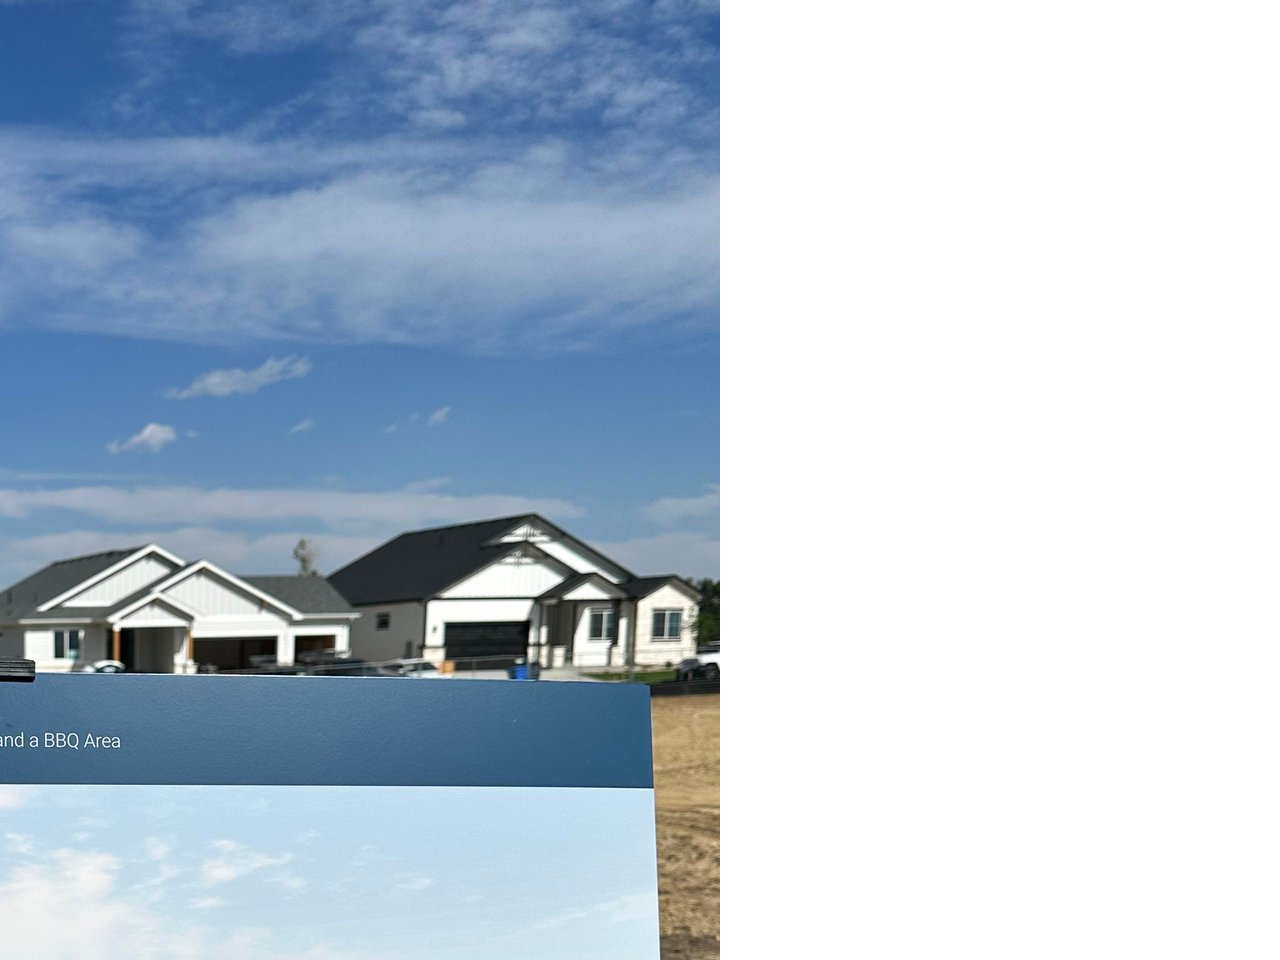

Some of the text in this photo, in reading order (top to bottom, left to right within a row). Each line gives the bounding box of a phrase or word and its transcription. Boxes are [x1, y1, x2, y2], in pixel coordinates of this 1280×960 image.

[29, 735, 39, 748] a
[44, 732, 79, 750] BBQ
[83, 733, 121, 749] Area
